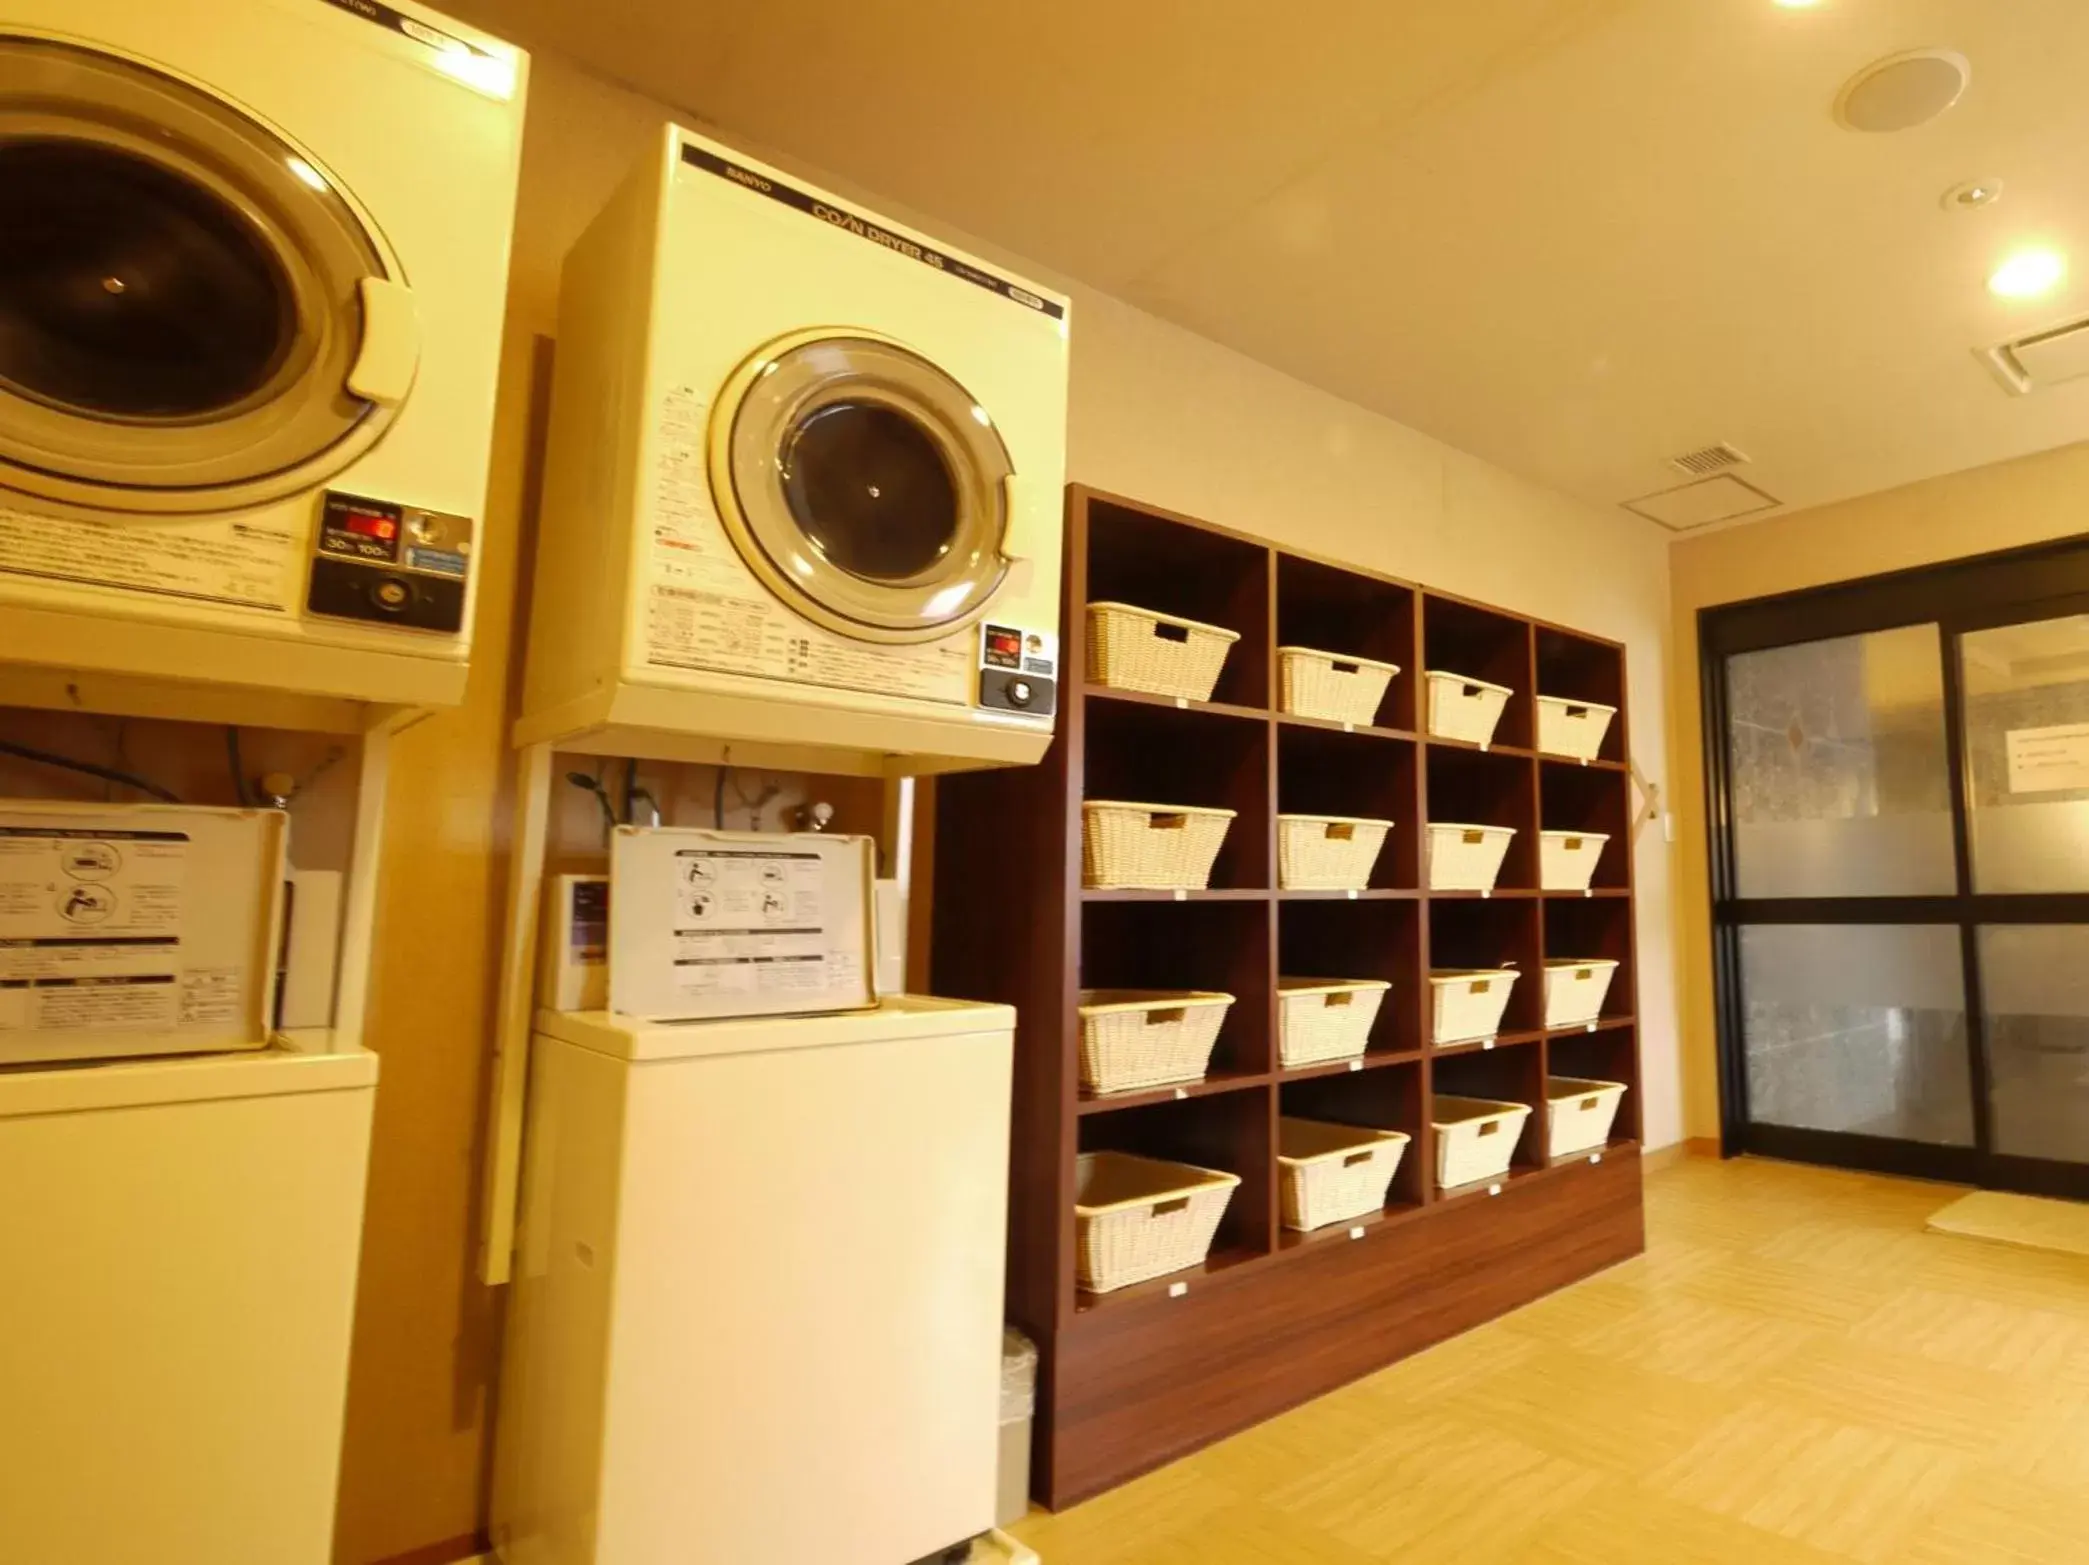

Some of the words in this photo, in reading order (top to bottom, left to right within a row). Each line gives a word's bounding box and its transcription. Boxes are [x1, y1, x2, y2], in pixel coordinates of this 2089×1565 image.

[725, 167, 772, 193] SANYO
[867, 226, 922, 262] DRYER
[924, 254, 944, 270] 45
